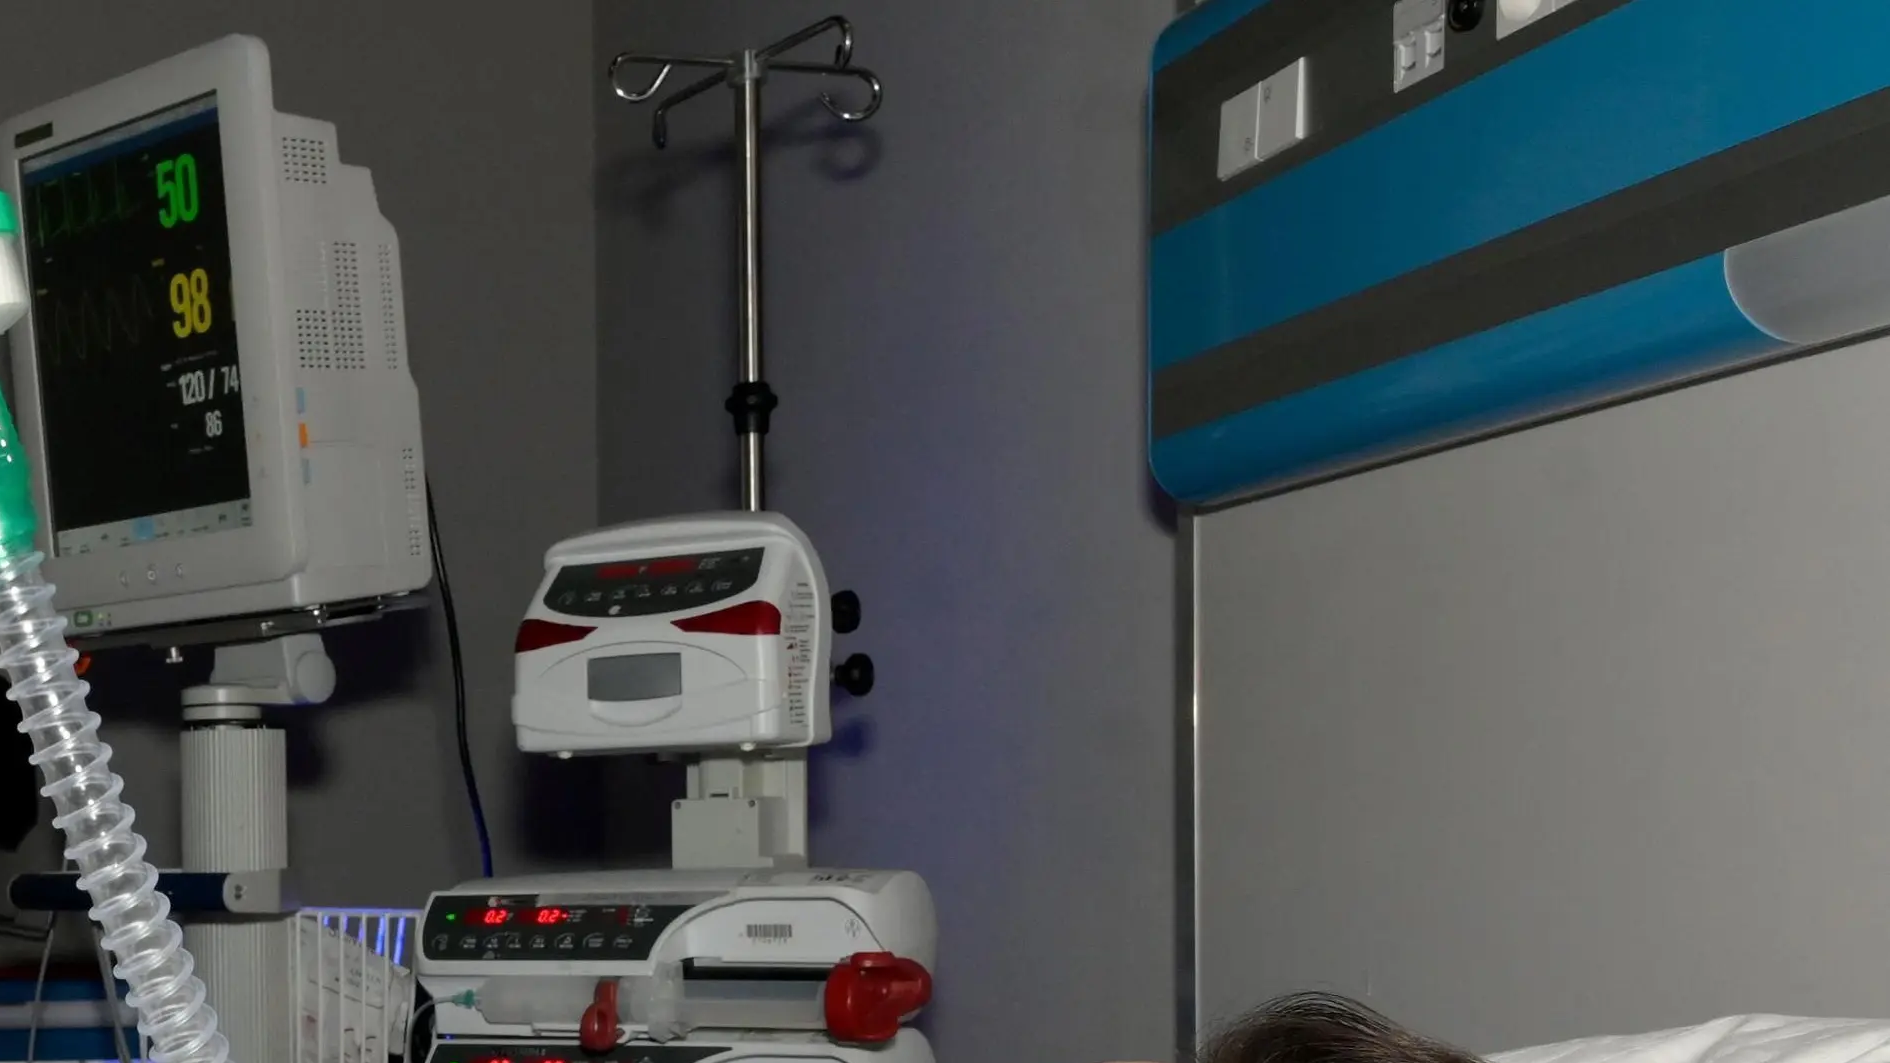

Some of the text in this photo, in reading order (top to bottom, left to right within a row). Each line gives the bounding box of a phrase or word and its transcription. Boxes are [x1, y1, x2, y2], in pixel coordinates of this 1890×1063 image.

[154, 151, 200, 230] 50
[168, 266, 214, 340] 98
[204, 408, 224, 438] 86
[483, 909, 508, 925] 0.2
[536, 909, 561, 925] 0.2
